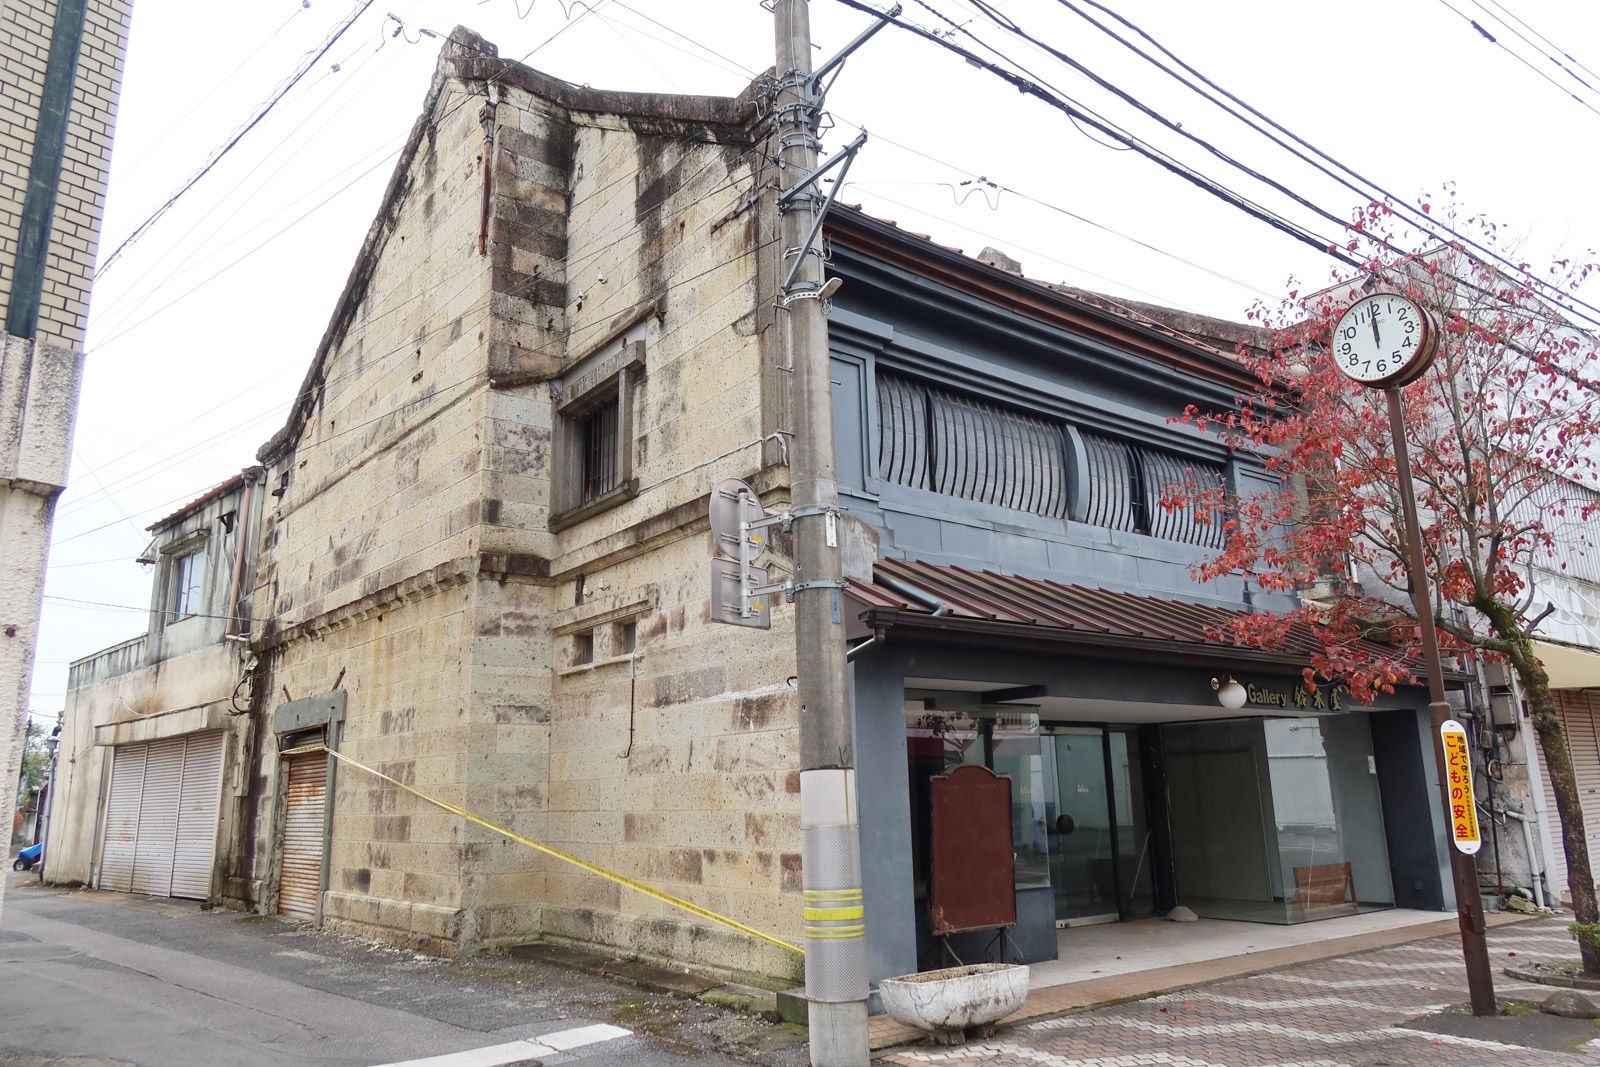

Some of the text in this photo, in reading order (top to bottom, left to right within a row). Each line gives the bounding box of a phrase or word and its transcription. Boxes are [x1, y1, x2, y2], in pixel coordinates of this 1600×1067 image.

[1367, 304, 1381, 318] 12
[1388, 302, 1392, 314] 1
[1397, 308, 1408, 320] 2
[1354, 312, 1365, 326] 11
[1344, 326, 1356, 340] 10
[1404, 320, 1414, 334] 3
[1342, 342, 1352, 355] 9
[1402, 336, 1412, 348] 4
[1348, 354, 1359, 366] 8
[1392, 350, 1402, 364] 5
[1362, 360, 1371, 373] 7
[1376, 360, 1386, 372] 6
[1248, 683, 1287, 706] Gallery
[1456, 736, 1470, 794] 地域で守ろう
[1446, 736, 1468, 838] こどもの安全
